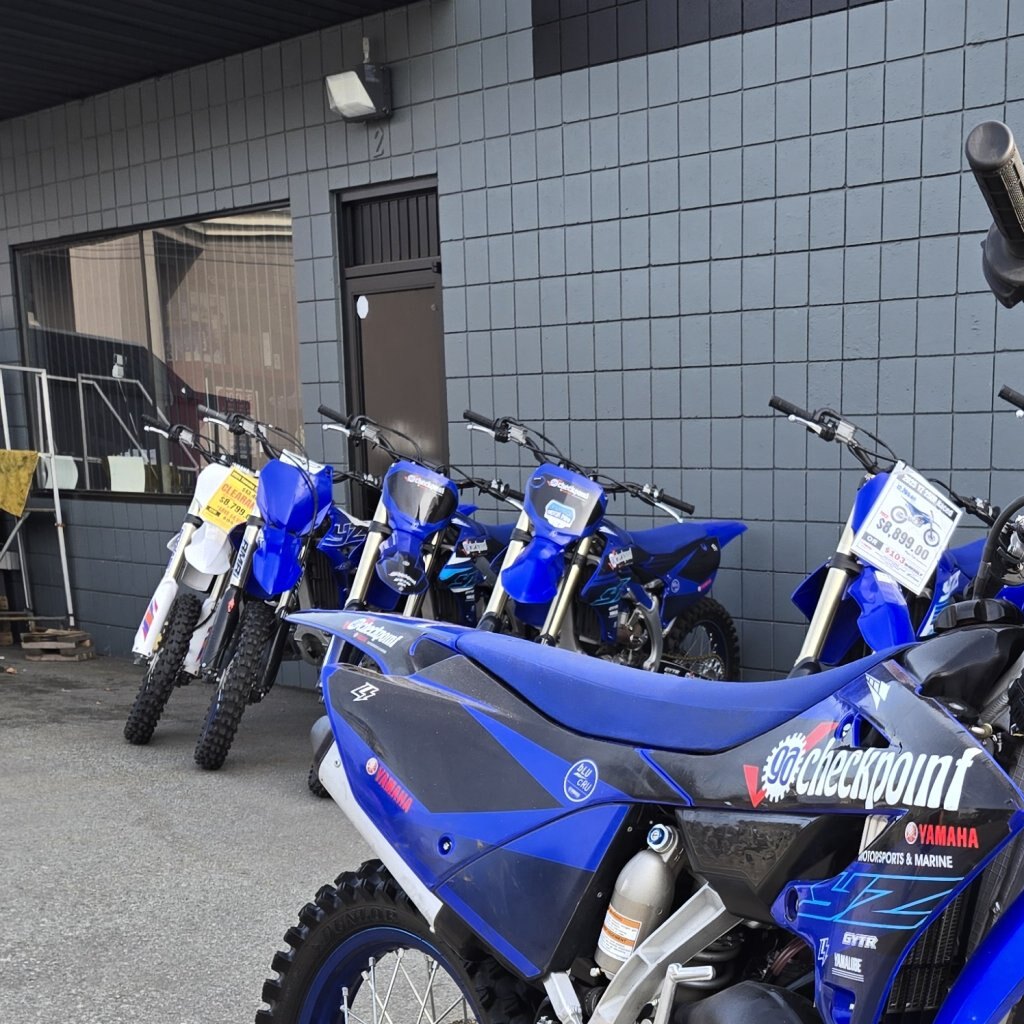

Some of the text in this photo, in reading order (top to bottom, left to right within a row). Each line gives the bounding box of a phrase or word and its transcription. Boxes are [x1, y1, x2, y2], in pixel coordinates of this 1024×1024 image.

[372, 127, 385, 158] 2
[866, 535, 878, 546] OR
[876, 517, 930, 561] $8,899.00
[885, 547, 906, 565] $103
[796, 739, 982, 811] checkpoint
[375, 769, 413, 813] YAMAHA
[918, 824, 979, 849] YAMAHA
[905, 854, 913, 866] &
[915, 855, 953, 869] MARINE
[842, 931, 878, 950] GYTR
